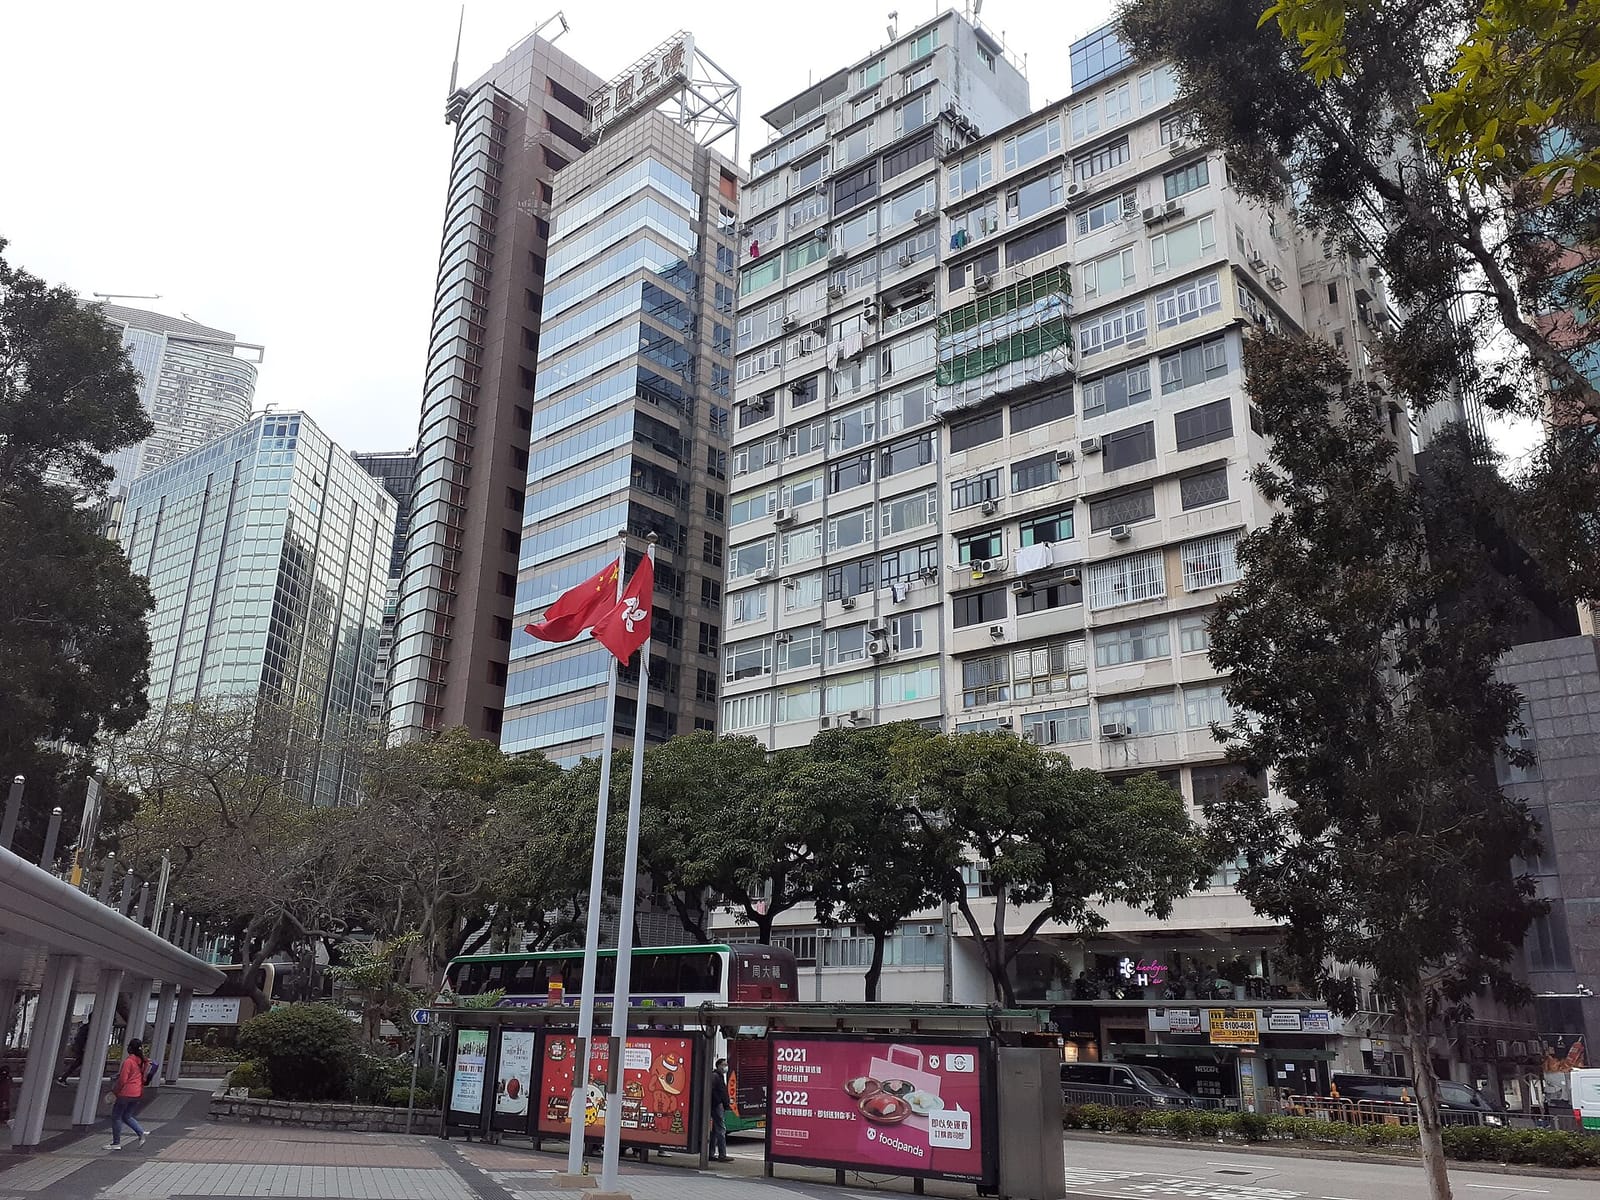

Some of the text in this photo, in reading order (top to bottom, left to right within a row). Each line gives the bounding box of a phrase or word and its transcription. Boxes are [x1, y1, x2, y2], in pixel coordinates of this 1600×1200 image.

[777, 1048, 806, 1062] 2021
[775, 1090, 808, 1106] 2022
[879, 1132, 924, 1157] foodpanda
